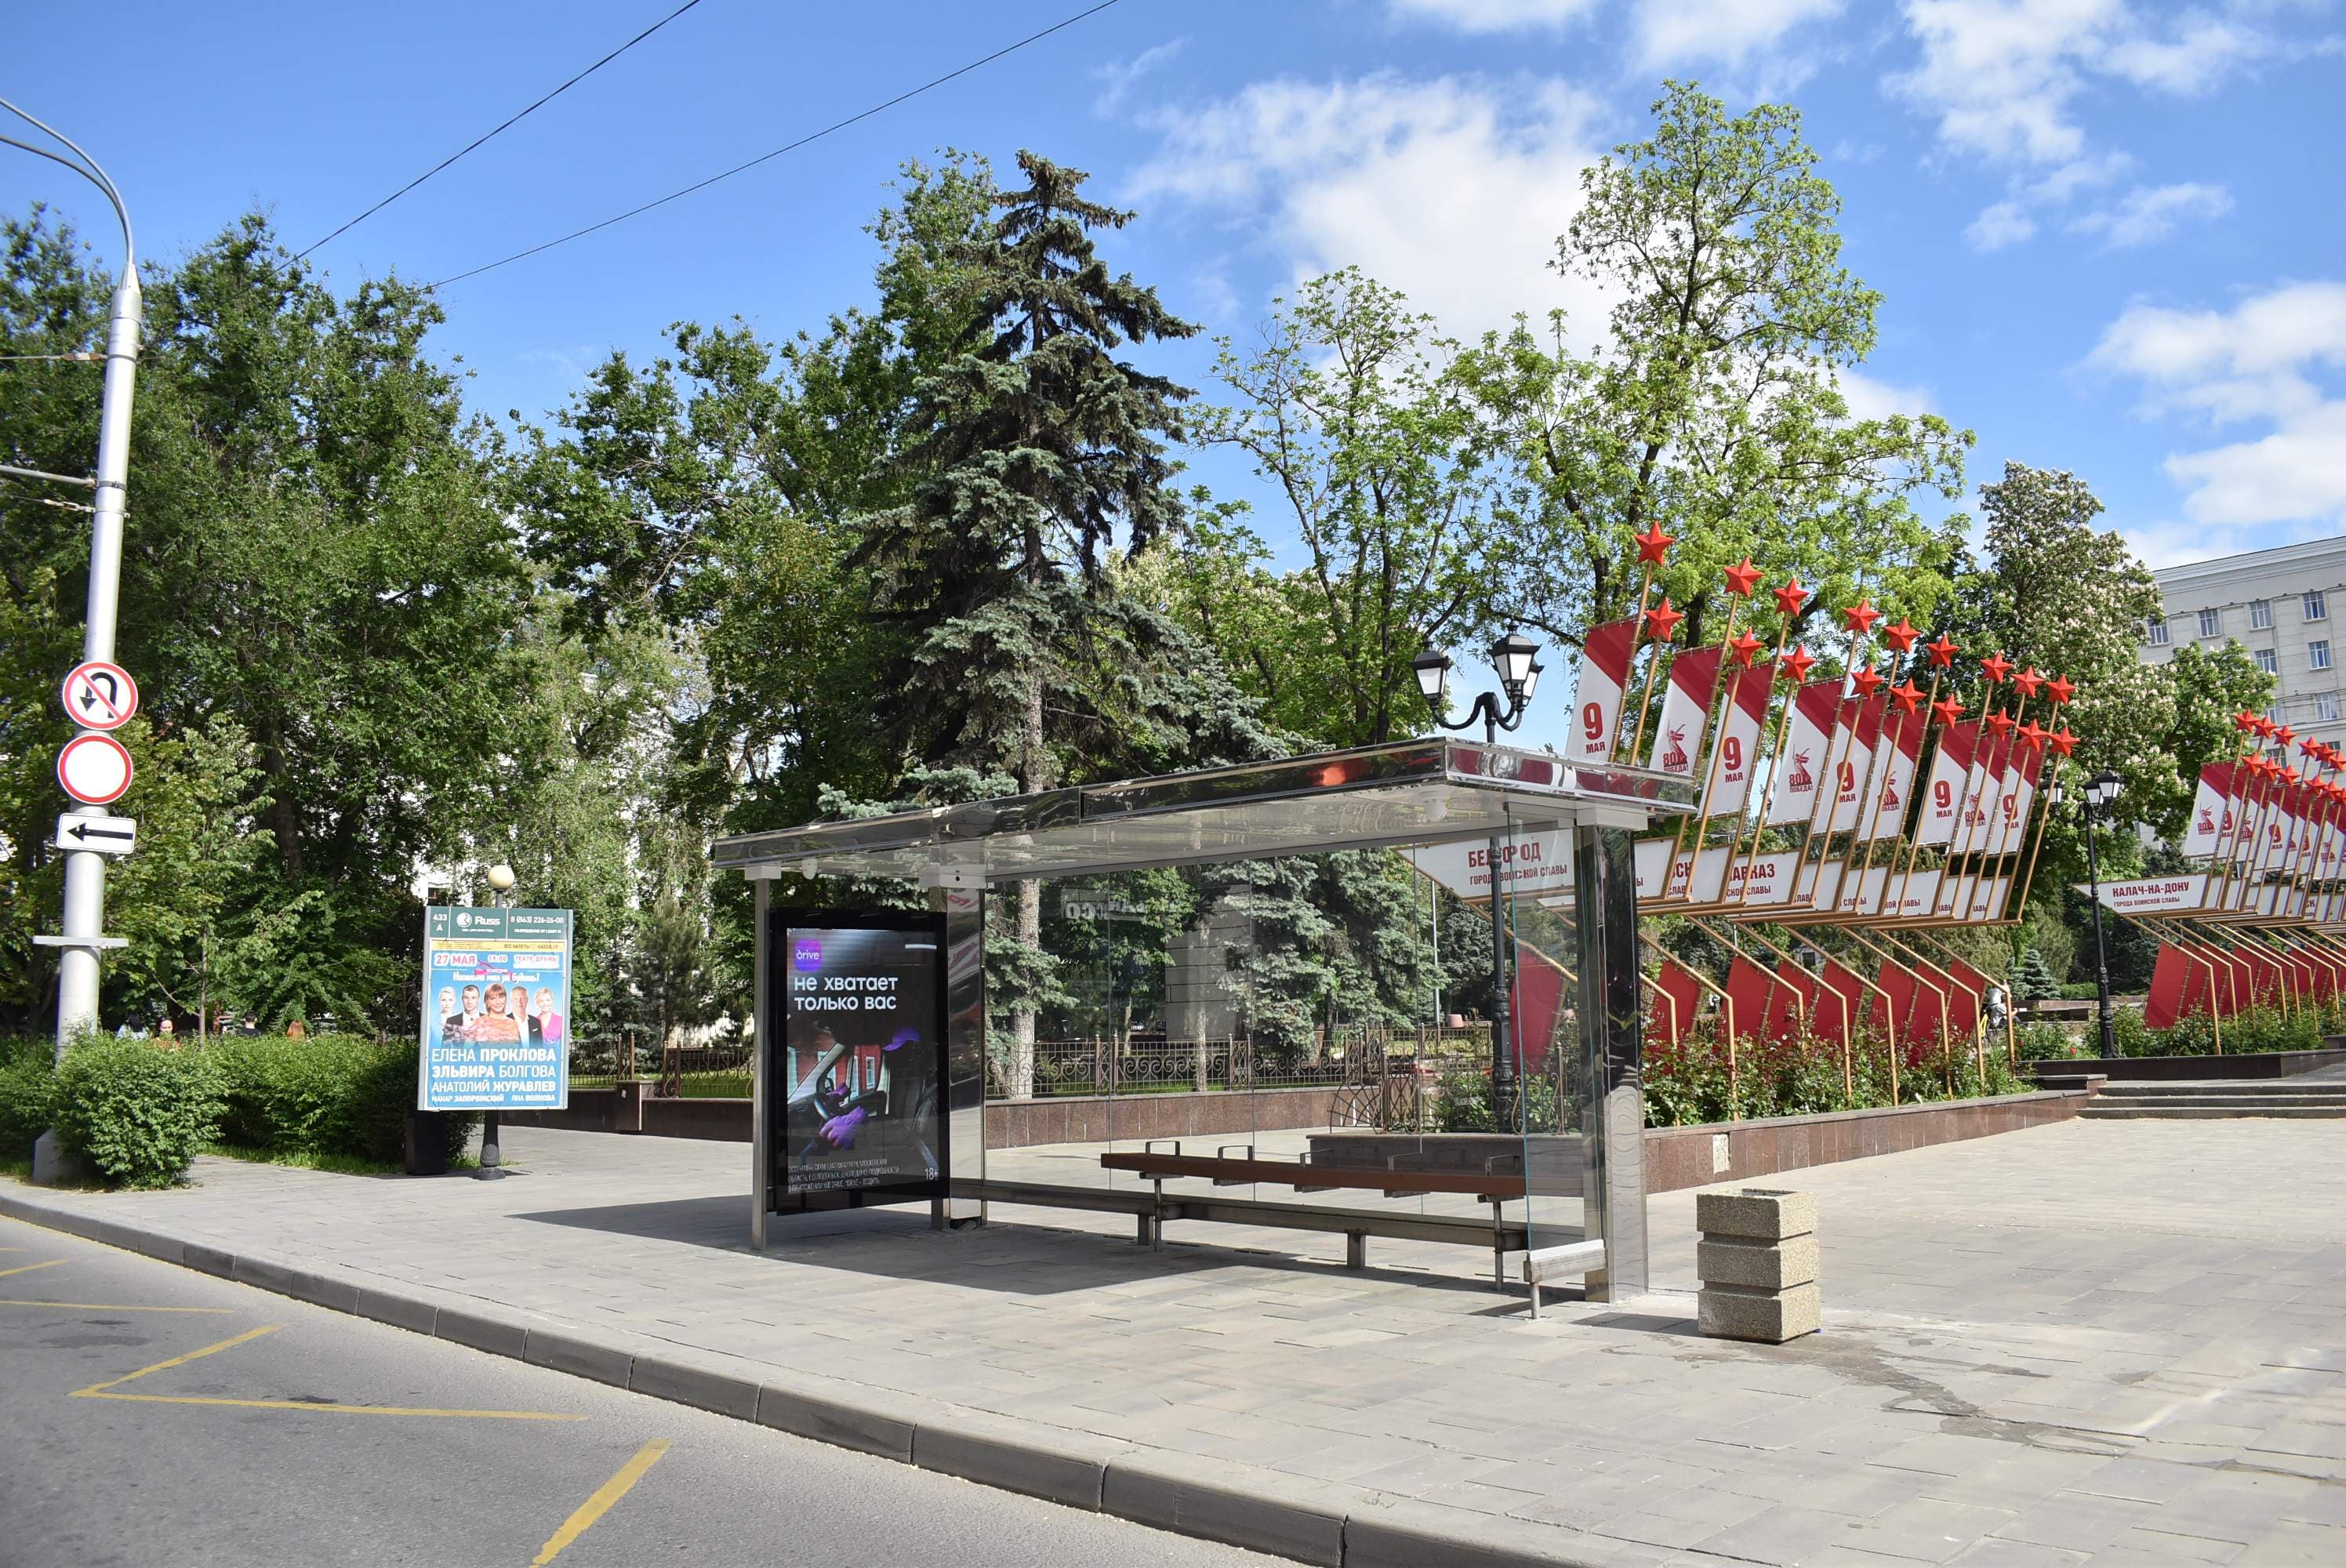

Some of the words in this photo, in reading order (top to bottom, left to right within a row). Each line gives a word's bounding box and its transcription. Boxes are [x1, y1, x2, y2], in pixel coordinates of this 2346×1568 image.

[1582, 702, 1603, 740] 9
[1586, 742, 1606, 754] МАЯ
[1723, 737, 1741, 771] 9
[1725, 772, 1744, 782] МАЯ
[1836, 760, 1854, 793] 9
[1839, 793, 1857, 804] МАЯ
[1934, 780, 1952, 808] 9
[2003, 794, 2018, 820] 9
[1937, 810, 1952, 818] МАЯ
[1540, 864, 1567, 877] СЛАВЫ
[1747, 885, 1771, 895] СЛАВЫ
[2112, 882, 2190, 897] КАЛАЧ-НА-ДОНУ
[475, 916, 501, 925] Russ
[437, 954, 449, 964] 27
[452, 954, 475, 965] МАЯ
[796, 949, 819, 960] drive
[794, 977, 818, 991] не
[824, 977, 899, 991] хватает
[794, 996, 859, 1011] только
[865, 996, 897, 1010] вас
[432, 1048, 476, 1062] ЕЛЕНА
[480, 1048, 557, 1062] ПРОКЛОВА
[432, 1065, 495, 1078] ЭЛЬВИРА
[499, 1065, 557, 1078] БОЛГОВА
[432, 1079, 490, 1092] АНАТОЛИЙ
[493, 1080, 556, 1092] ЖУРАВЛЕВ
[924, 1167, 939, 1180] 18+
